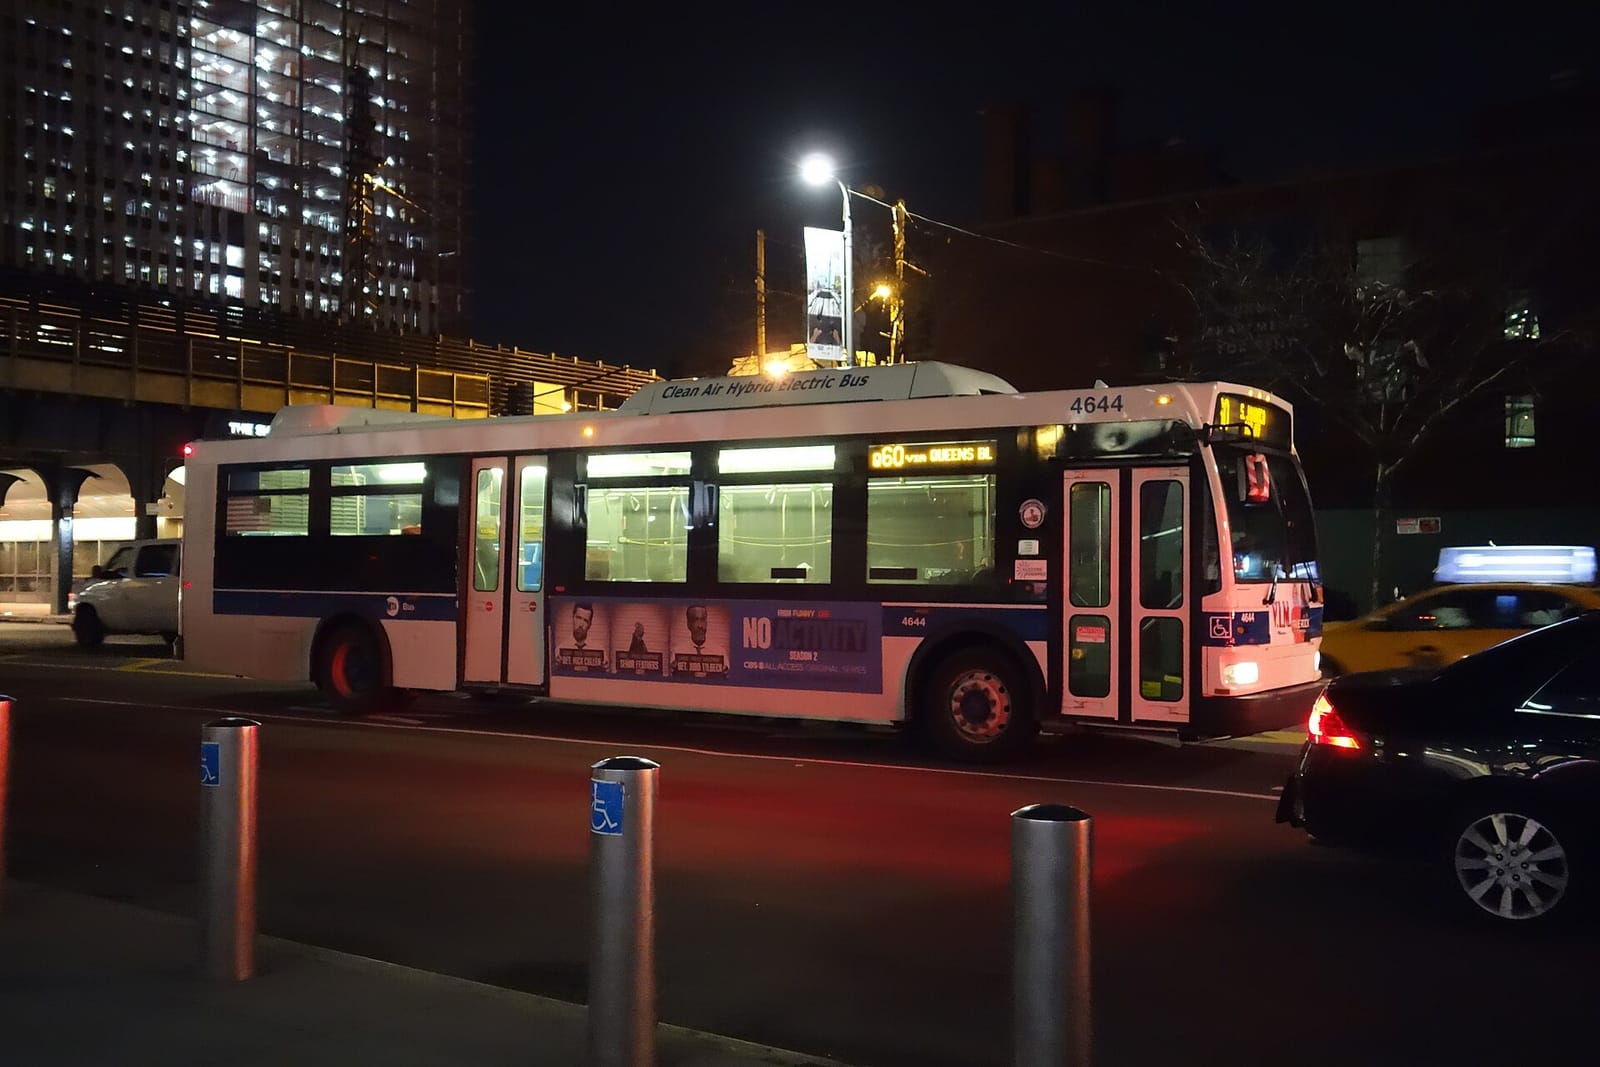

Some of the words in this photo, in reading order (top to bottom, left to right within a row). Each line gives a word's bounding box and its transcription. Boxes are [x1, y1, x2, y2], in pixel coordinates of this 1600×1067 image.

[662, 385, 699, 399] Clean
[701, 383, 723, 397] Air
[727, 379, 773, 397] Hybrid
[778, 377, 833, 392] Electric
[839, 374, 870, 388] Bus
[1070, 395, 1124, 414] 4644
[929, 447, 975, 462] QUEENS
[977, 446, 993, 460] BL
[901, 616, 926, 627] 4644
[743, 617, 771, 649] NO
[774, 619, 867, 651] ACTIVITY
[789, 651, 813, 661] SEASON
[813, 651, 819, 661] 2
